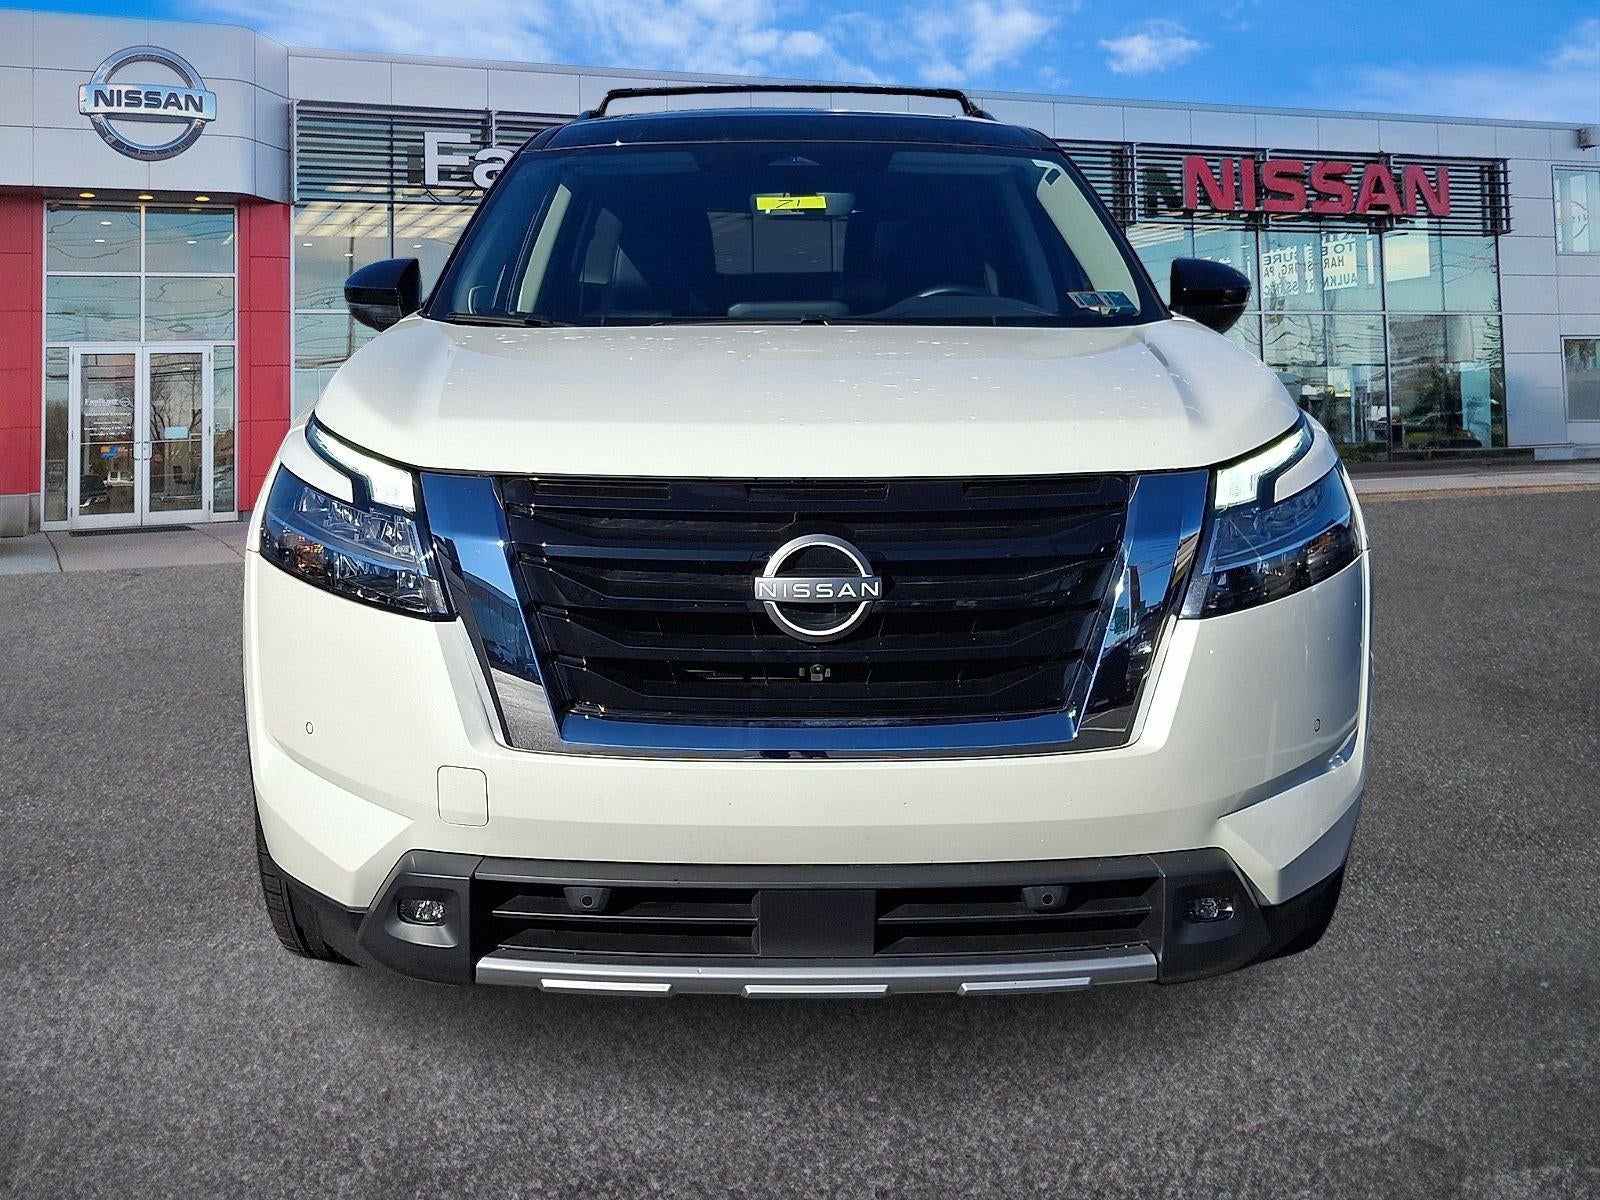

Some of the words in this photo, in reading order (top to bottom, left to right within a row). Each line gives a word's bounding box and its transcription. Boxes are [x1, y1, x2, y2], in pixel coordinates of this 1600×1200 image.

[93, 89, 204, 113] NISSAN
[1182, 154, 1450, 217] NISSAN
[758, 581, 879, 598] NISSAN
